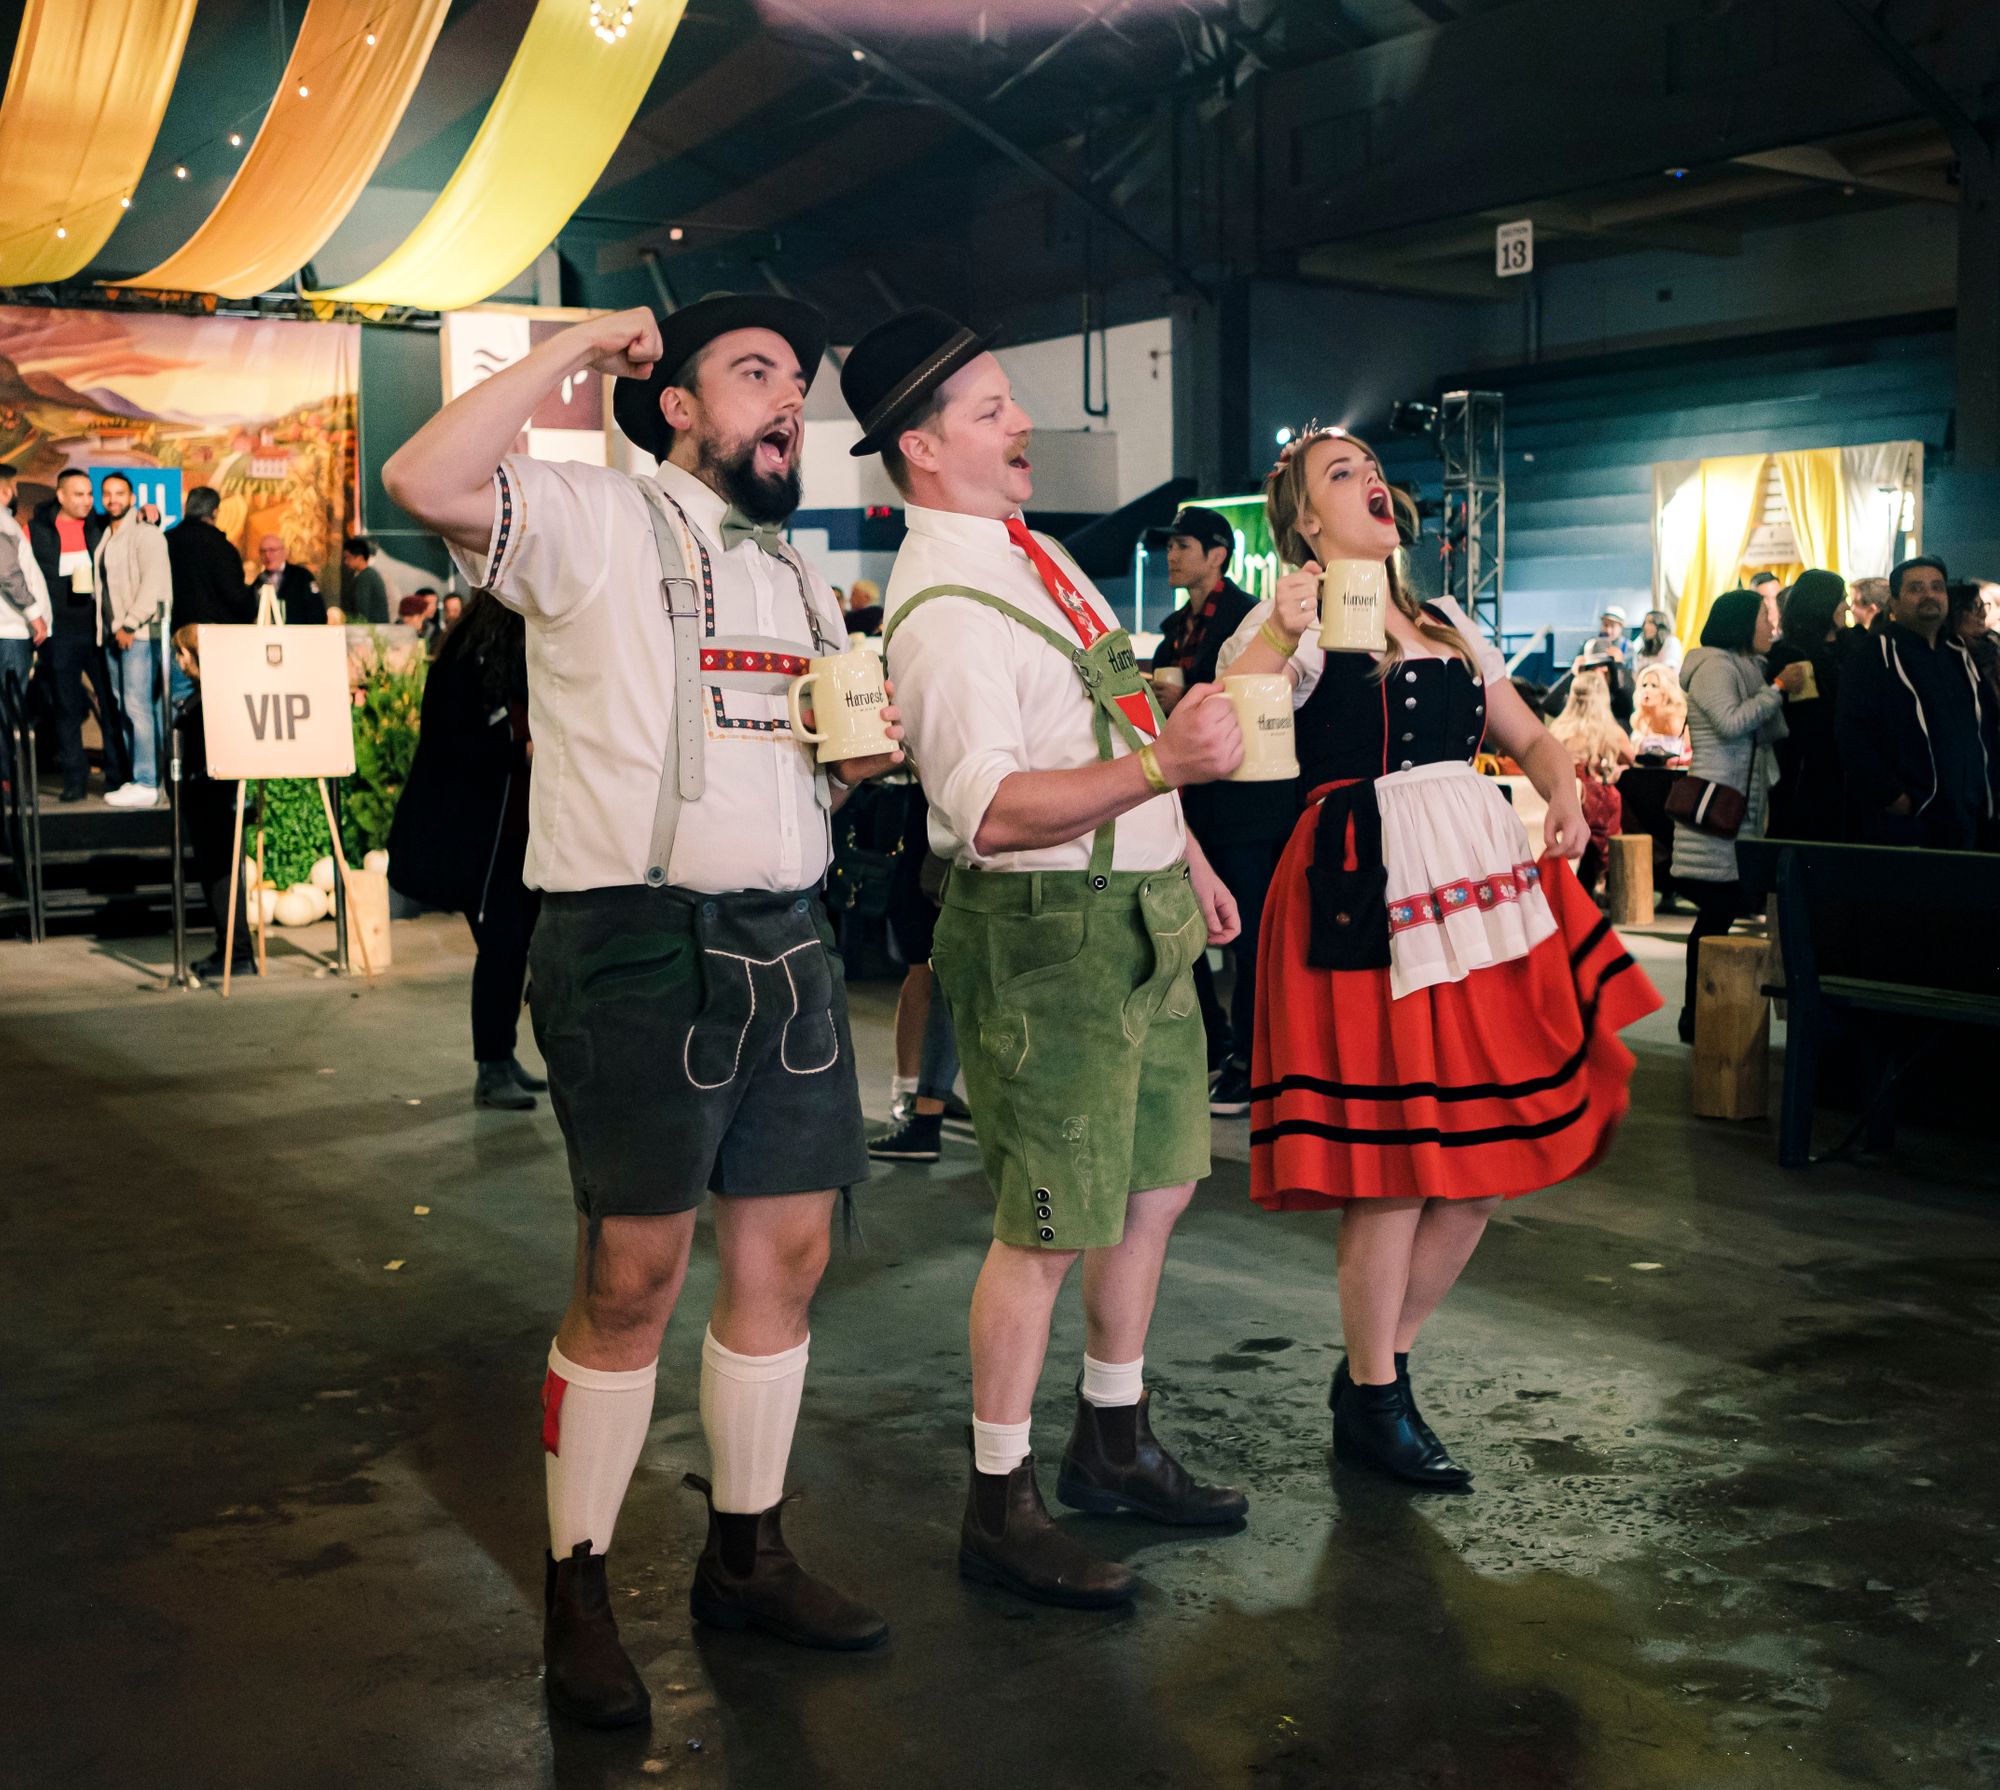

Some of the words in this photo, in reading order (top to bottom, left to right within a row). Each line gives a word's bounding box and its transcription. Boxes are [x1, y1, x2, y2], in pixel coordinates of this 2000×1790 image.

[1502, 240, 1527, 270] 13
[1107, 645, 1137, 674] Harv
[844, 684, 884, 708] Harvest
[244, 694, 311, 741] VIP
